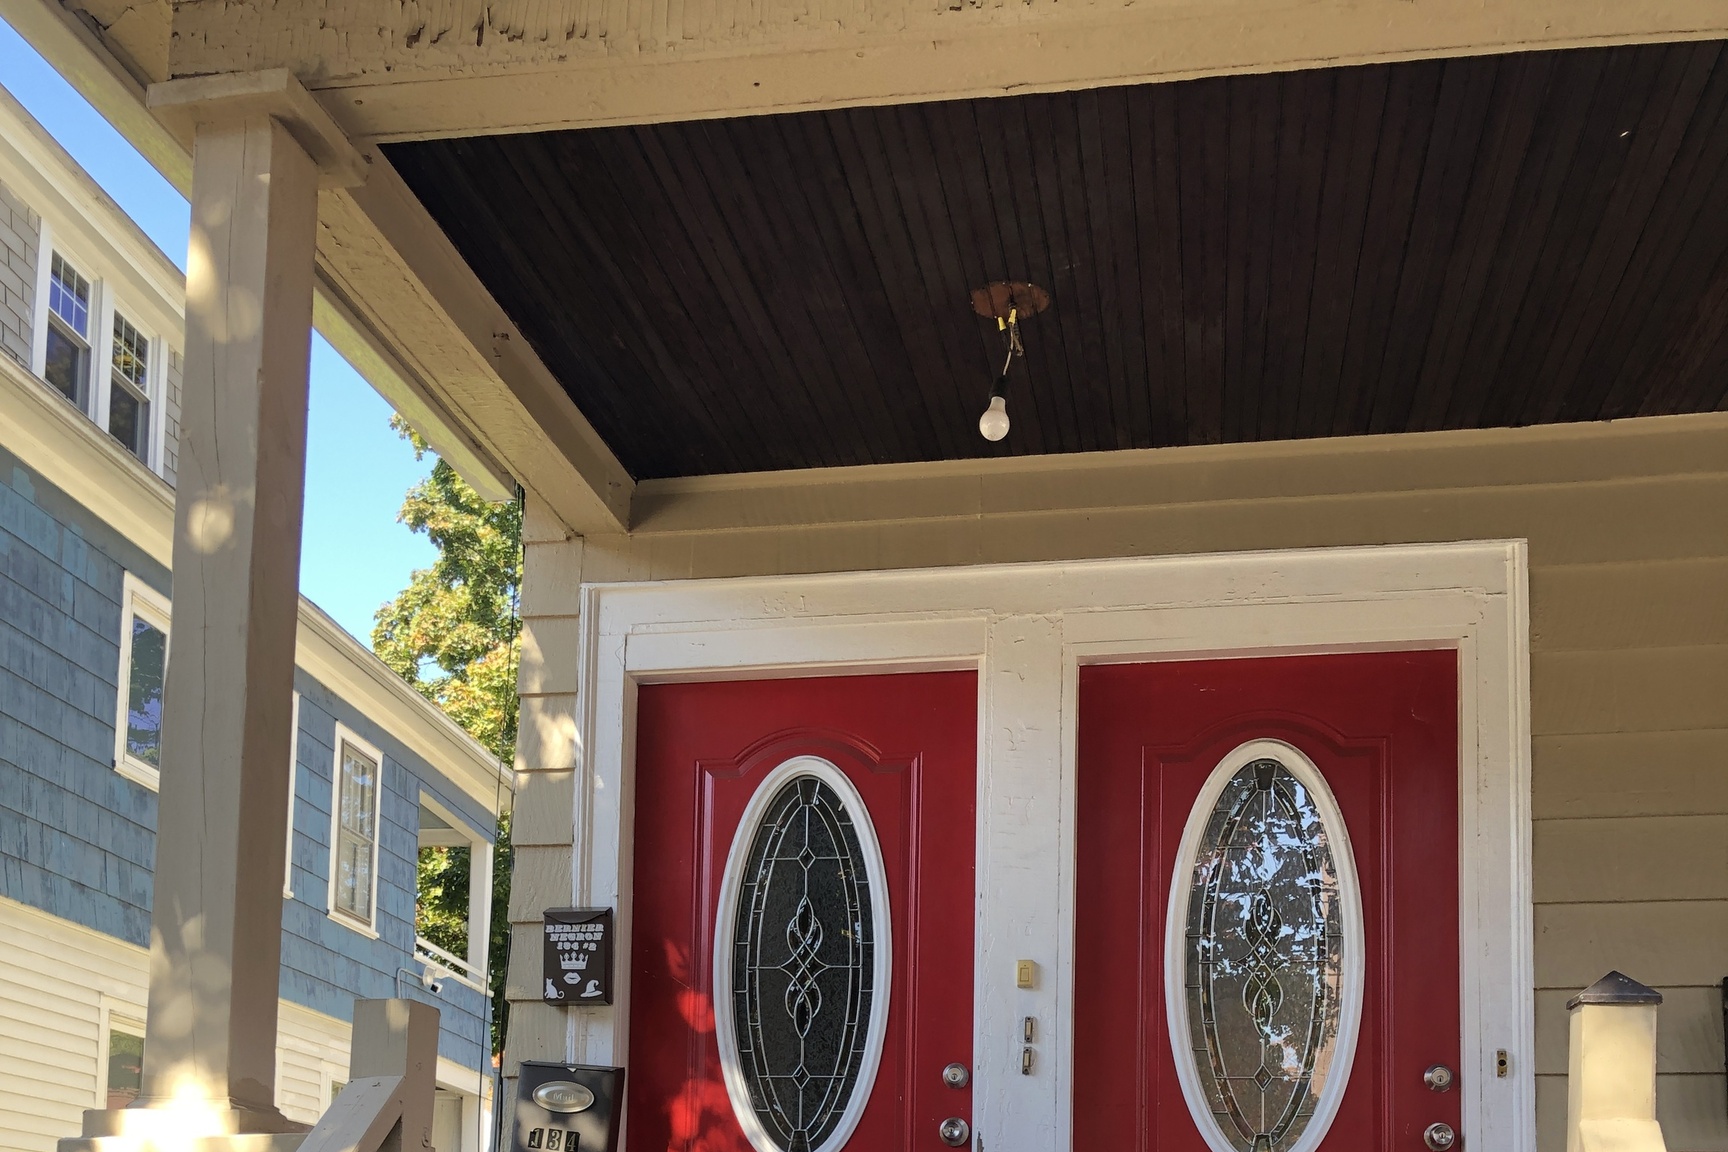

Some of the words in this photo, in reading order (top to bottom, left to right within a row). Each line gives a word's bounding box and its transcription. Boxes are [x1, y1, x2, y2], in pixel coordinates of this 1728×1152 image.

[545, 923, 604, 933] BERNIER
[549, 932, 603, 942] NEGRON
[582, 942, 597, 951] #2
[552, 1092, 575, 1102] Mail
[529, 1128, 578, 1152] 134
